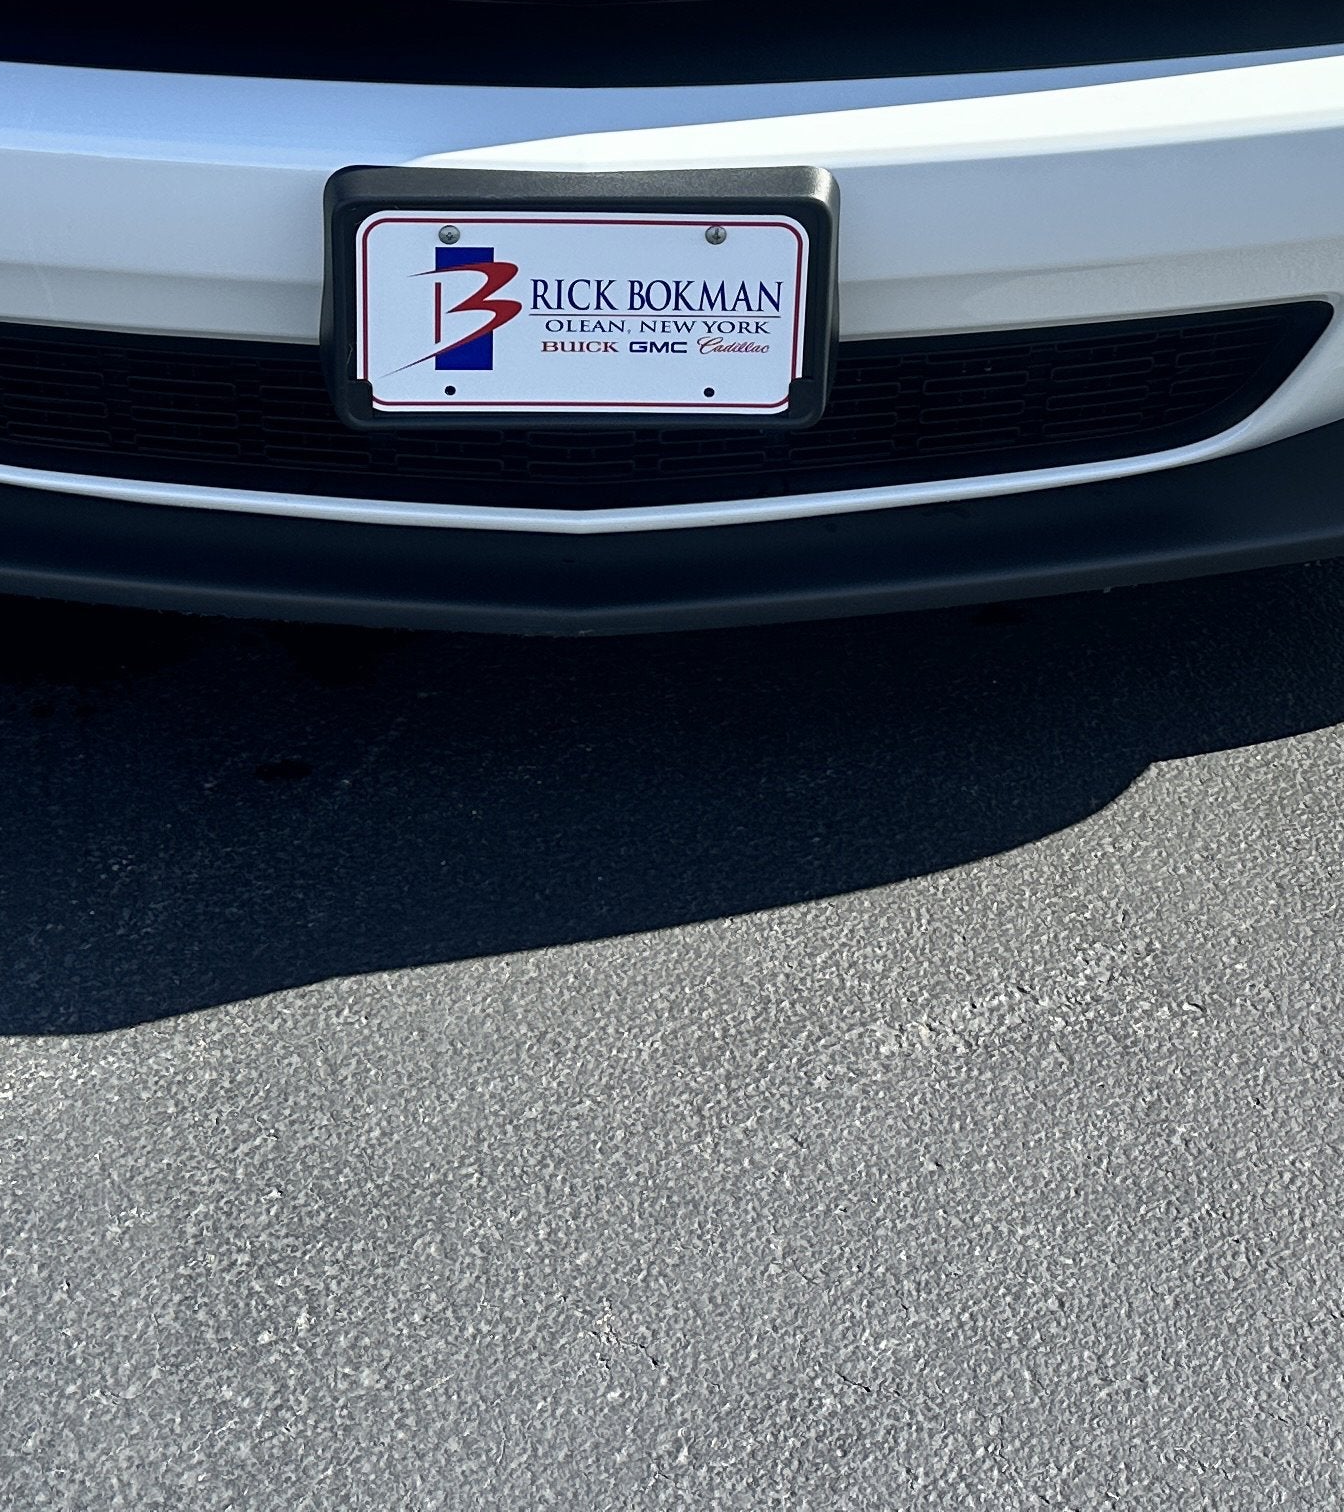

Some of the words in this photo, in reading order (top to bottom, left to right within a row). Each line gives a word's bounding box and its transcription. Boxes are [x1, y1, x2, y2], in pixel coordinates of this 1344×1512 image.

[530, 278, 619, 311] RICK
[627, 280, 784, 313] BOKMAN
[545, 319, 632, 335] OLEAN,
[639, 319, 697, 334] NEW
[701, 320, 771, 335] YORK
[540, 340, 619, 353] BUICK
[628, 340, 688, 354] GMC
[696, 336, 770, 355] Cadillac
